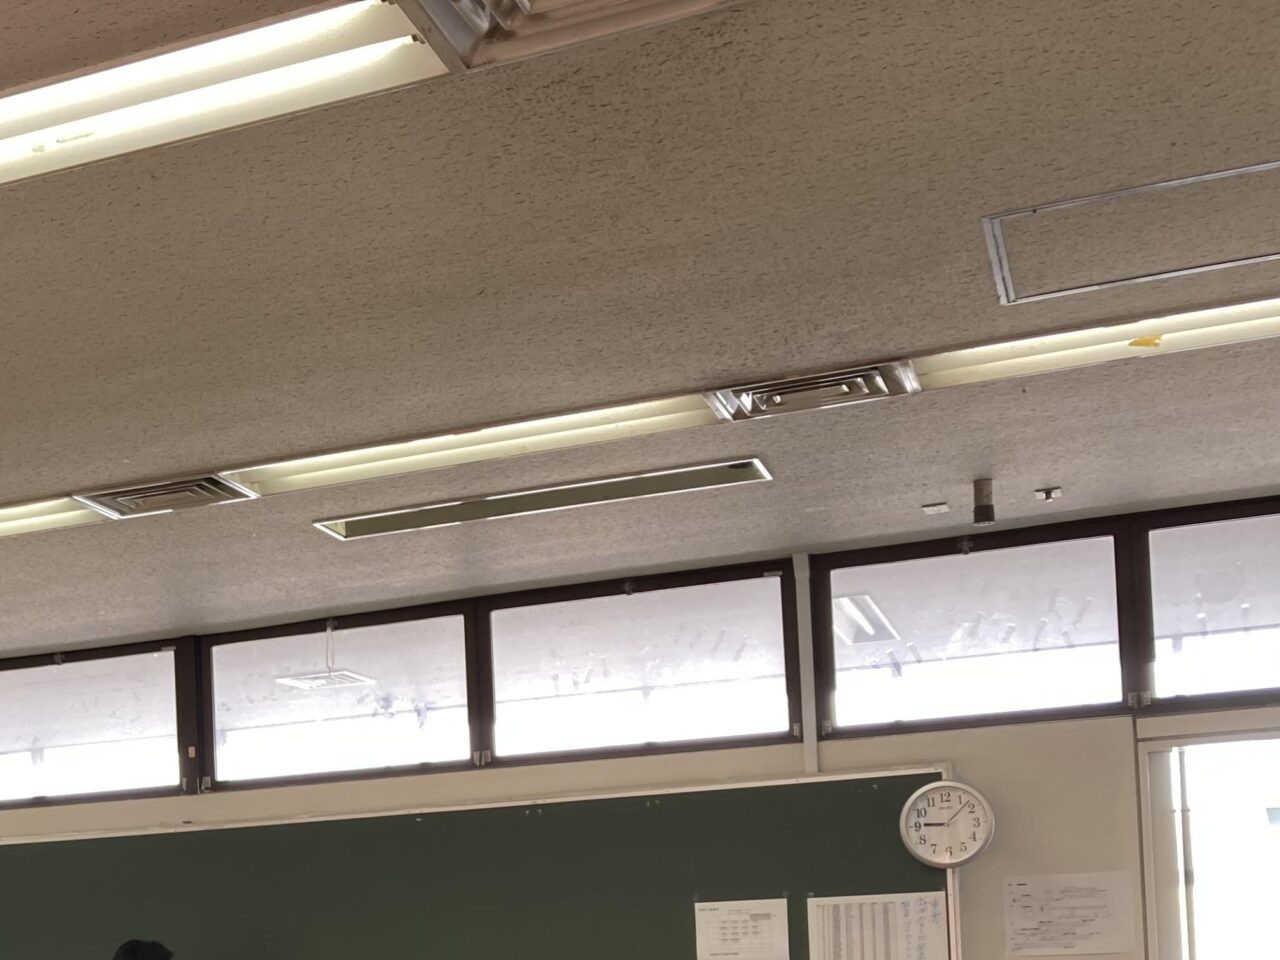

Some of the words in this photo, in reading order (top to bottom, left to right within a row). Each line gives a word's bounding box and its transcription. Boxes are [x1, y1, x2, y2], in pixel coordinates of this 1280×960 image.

[926, 797, 935, 807] 11
[940, 791, 951, 803] 12
[958, 795, 962, 805] 1
[916, 807, 927, 818] 10
[967, 803, 976, 814] 2
[914, 821, 922, 832] 9
[973, 817, 981, 828] 3
[919, 834, 927, 845] 8
[969, 831, 977, 842] 4
[930, 843, 938, 855] 7
[945, 846, 953, 856] 6
[960, 842, 968, 852] 5
